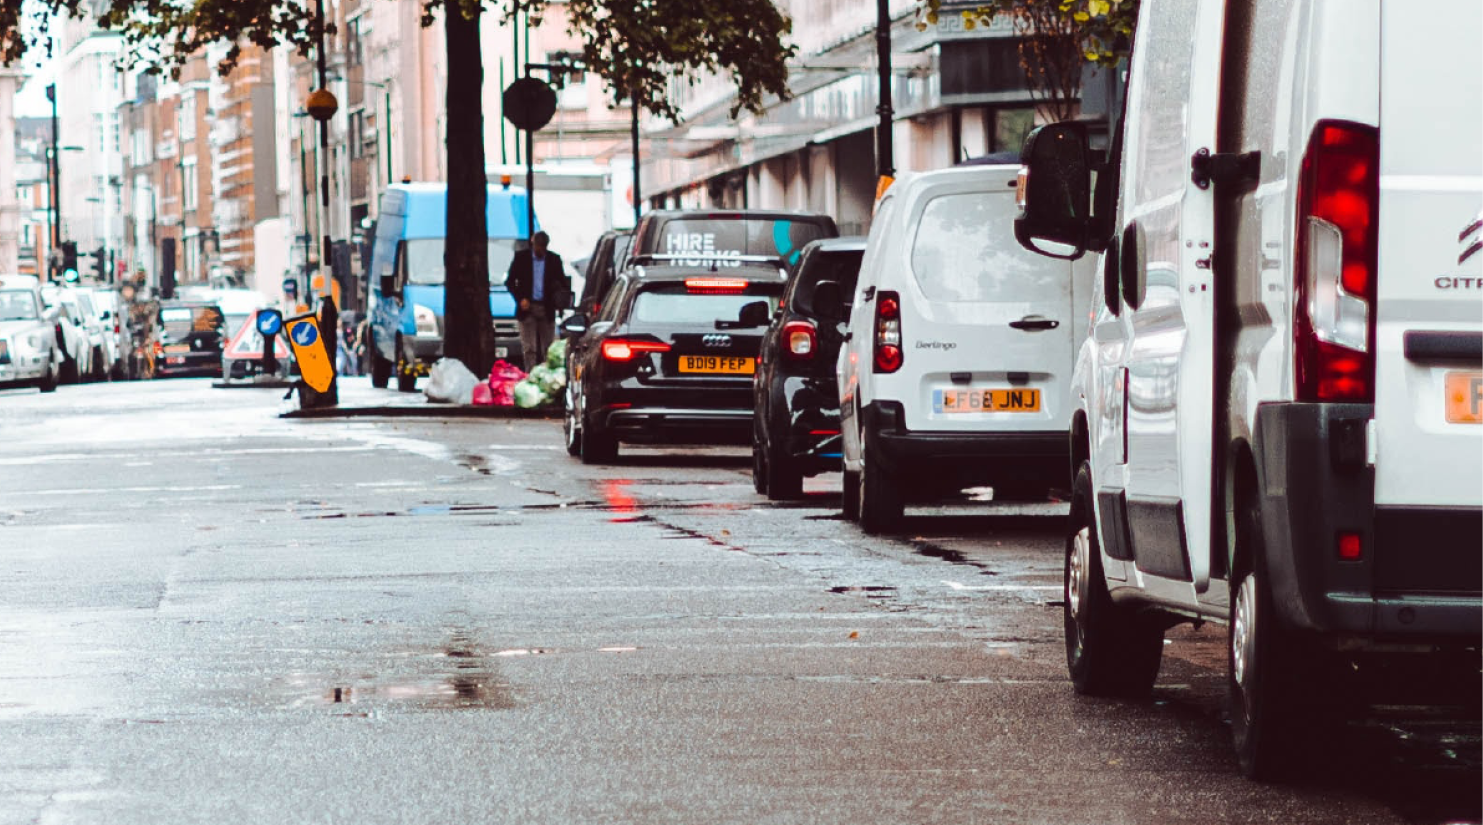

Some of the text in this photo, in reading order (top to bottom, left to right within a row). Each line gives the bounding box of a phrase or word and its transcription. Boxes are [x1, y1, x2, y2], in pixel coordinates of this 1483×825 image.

[667, 233, 715, 250] HIRE
[667, 250, 741, 267] WORKS
[915, 340, 957, 351] Berlingo
[687, 357, 746, 370] BD19 FEP
[999, 392, 1035, 408] JNJ
